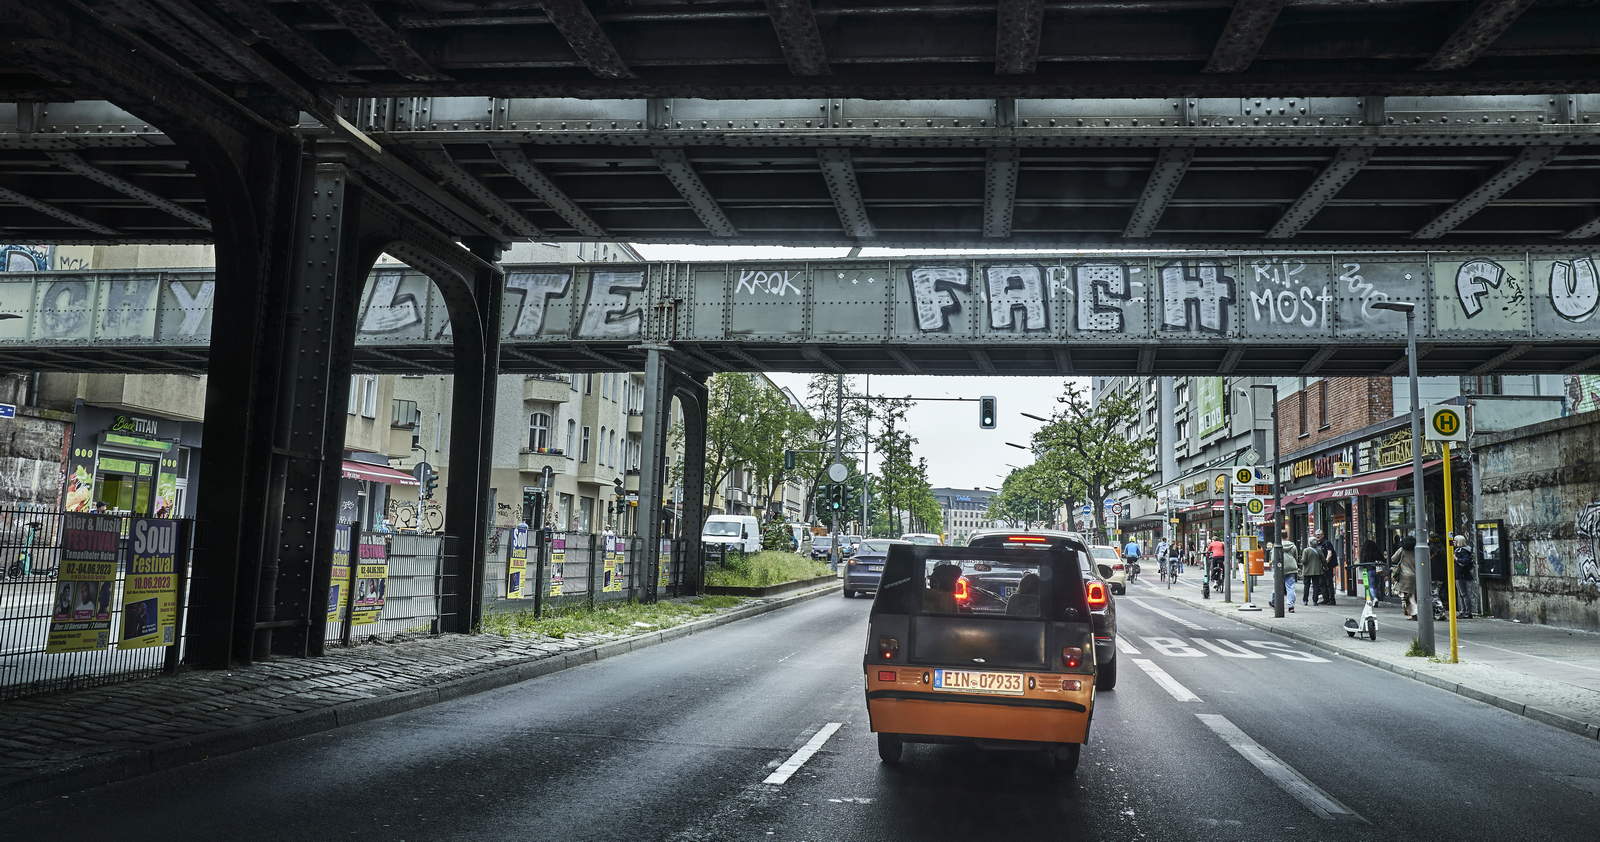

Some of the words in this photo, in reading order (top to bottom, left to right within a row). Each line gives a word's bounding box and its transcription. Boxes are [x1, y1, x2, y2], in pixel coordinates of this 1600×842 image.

[735, 268, 801, 296] KROK
[66, 515, 86, 530] Bier
[134, 519, 177, 554] Soul
[132, 554, 175, 573] Festival
[1139, 636, 1333, 663] BUS
[944, 672, 970, 687] EIN
[979, 674, 1021, 690] 07933
